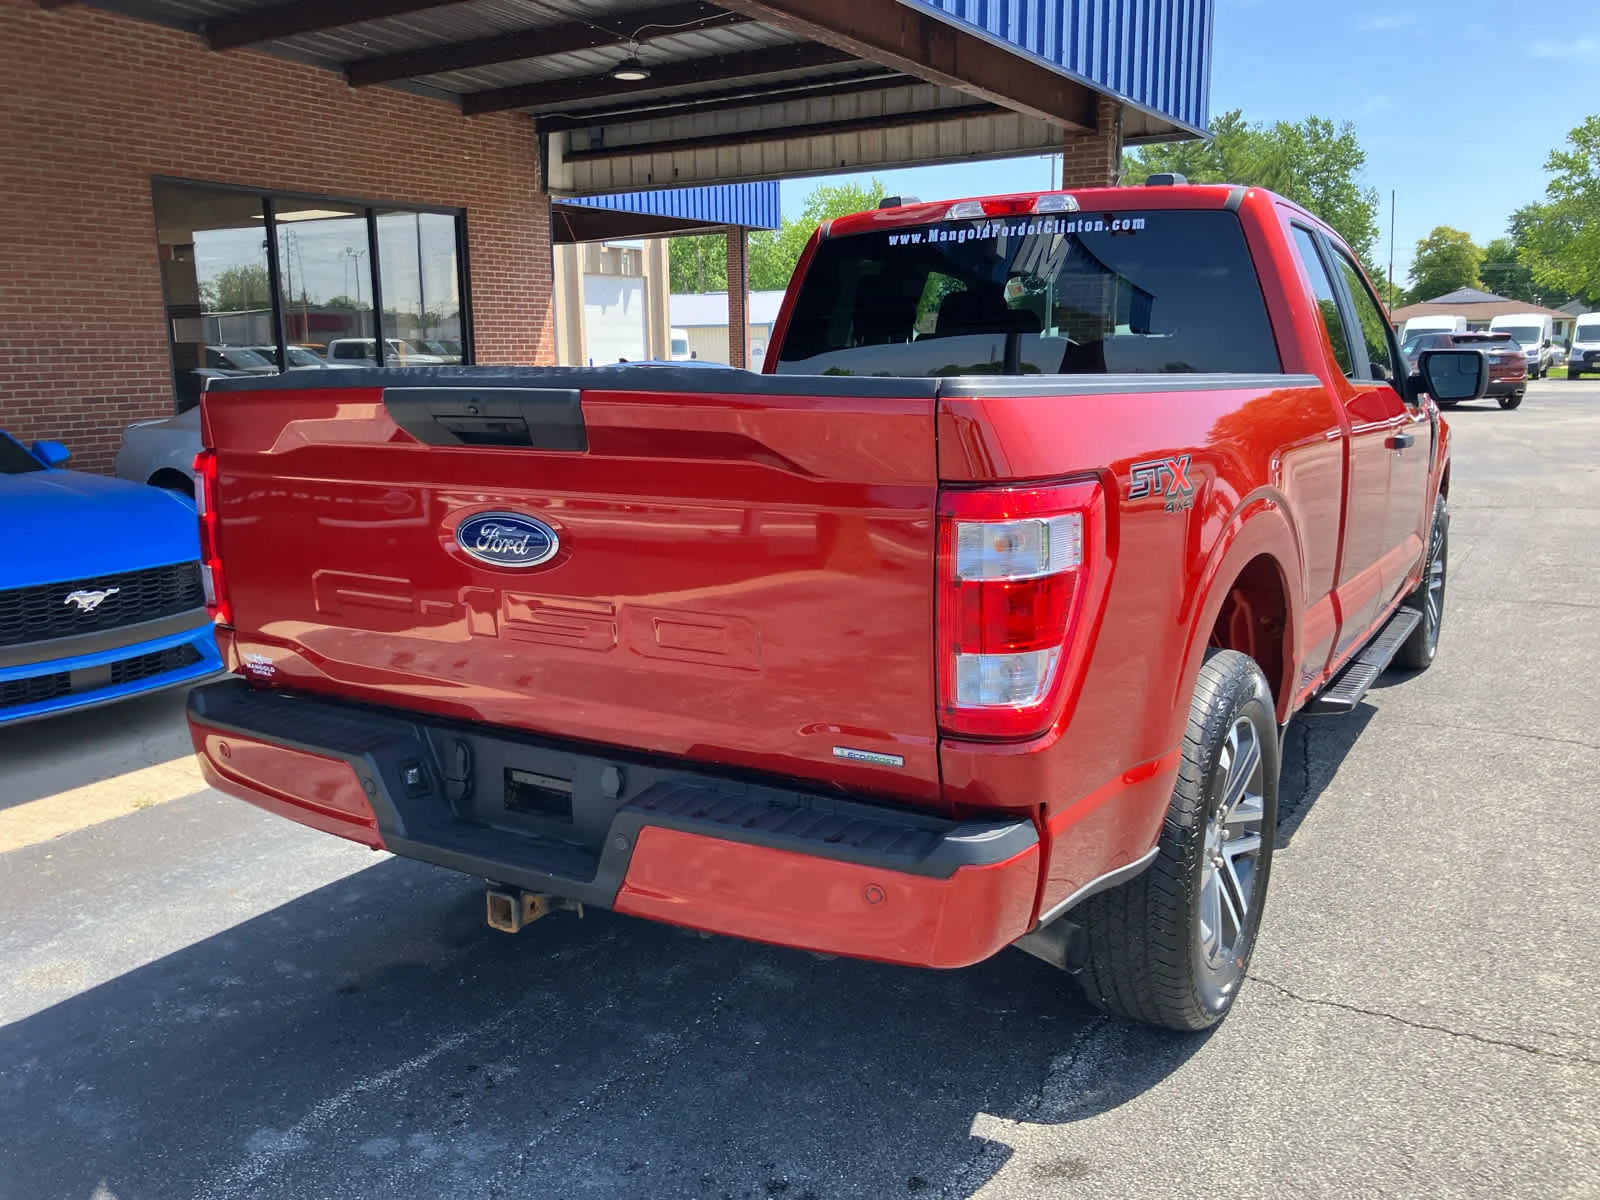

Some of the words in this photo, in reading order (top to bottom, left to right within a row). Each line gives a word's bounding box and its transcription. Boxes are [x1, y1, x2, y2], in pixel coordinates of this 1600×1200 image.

[888, 218, 1145, 246] www.MangoldFordofClinton.com
[1129, 454, 1193, 499] STX
[476, 523, 531, 555] Ford
[312, 569, 764, 672] F-150
